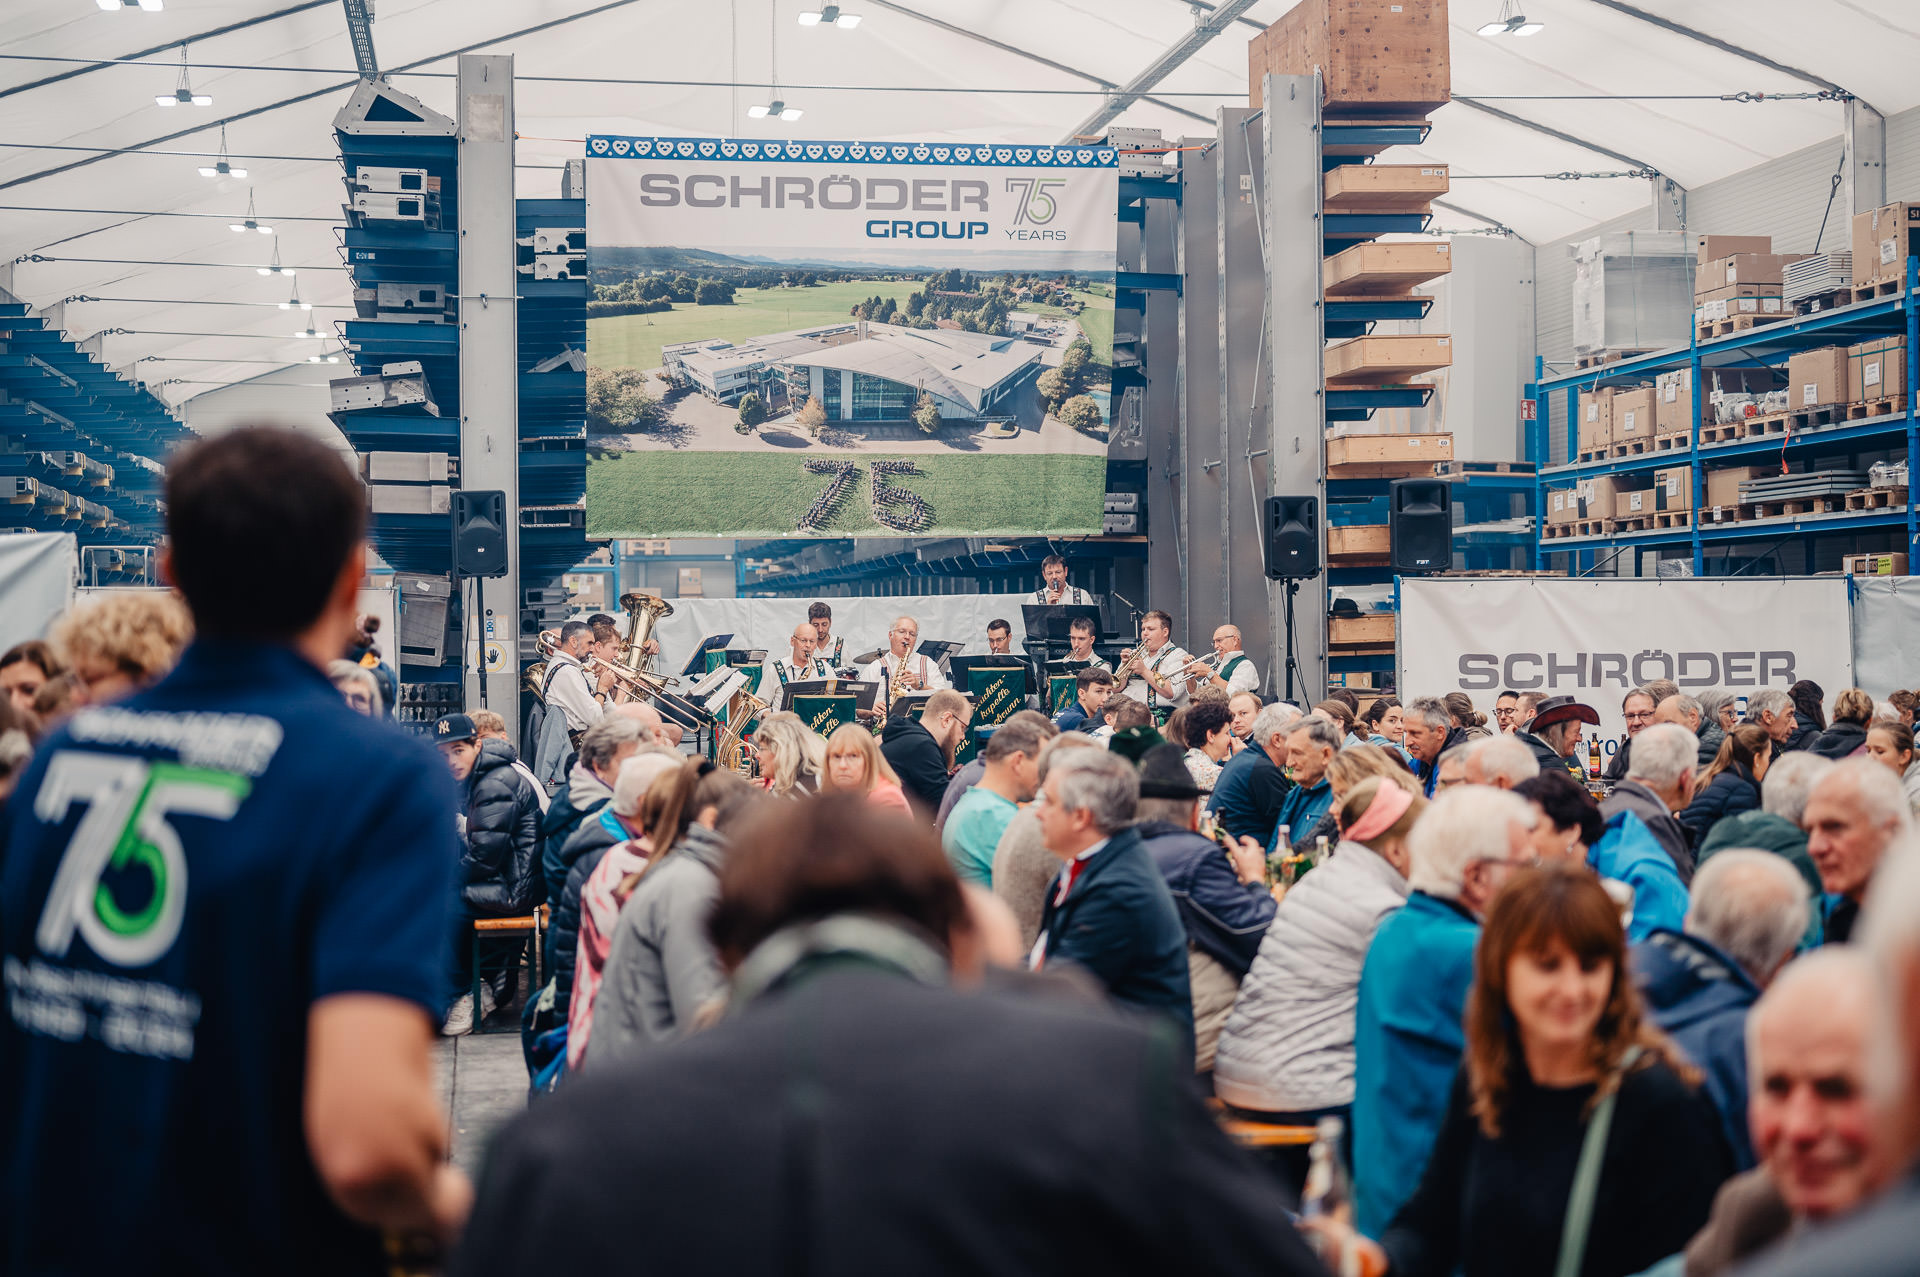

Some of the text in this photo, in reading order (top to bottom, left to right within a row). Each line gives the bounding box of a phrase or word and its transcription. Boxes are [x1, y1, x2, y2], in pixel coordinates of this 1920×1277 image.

[640, 173, 989, 212] SCHRÖDER
[1005, 177, 1067, 225] 75
[866, 220, 989, 240] GROUP
[1005, 229, 1067, 241] YEARS
[798, 459, 925, 532] 75
[1458, 649, 1797, 690] SCHRÖDER
[980, 688, 1011, 720] kapelle
[822, 718, 840, 736] elle
[34, 751, 253, 969] 75
